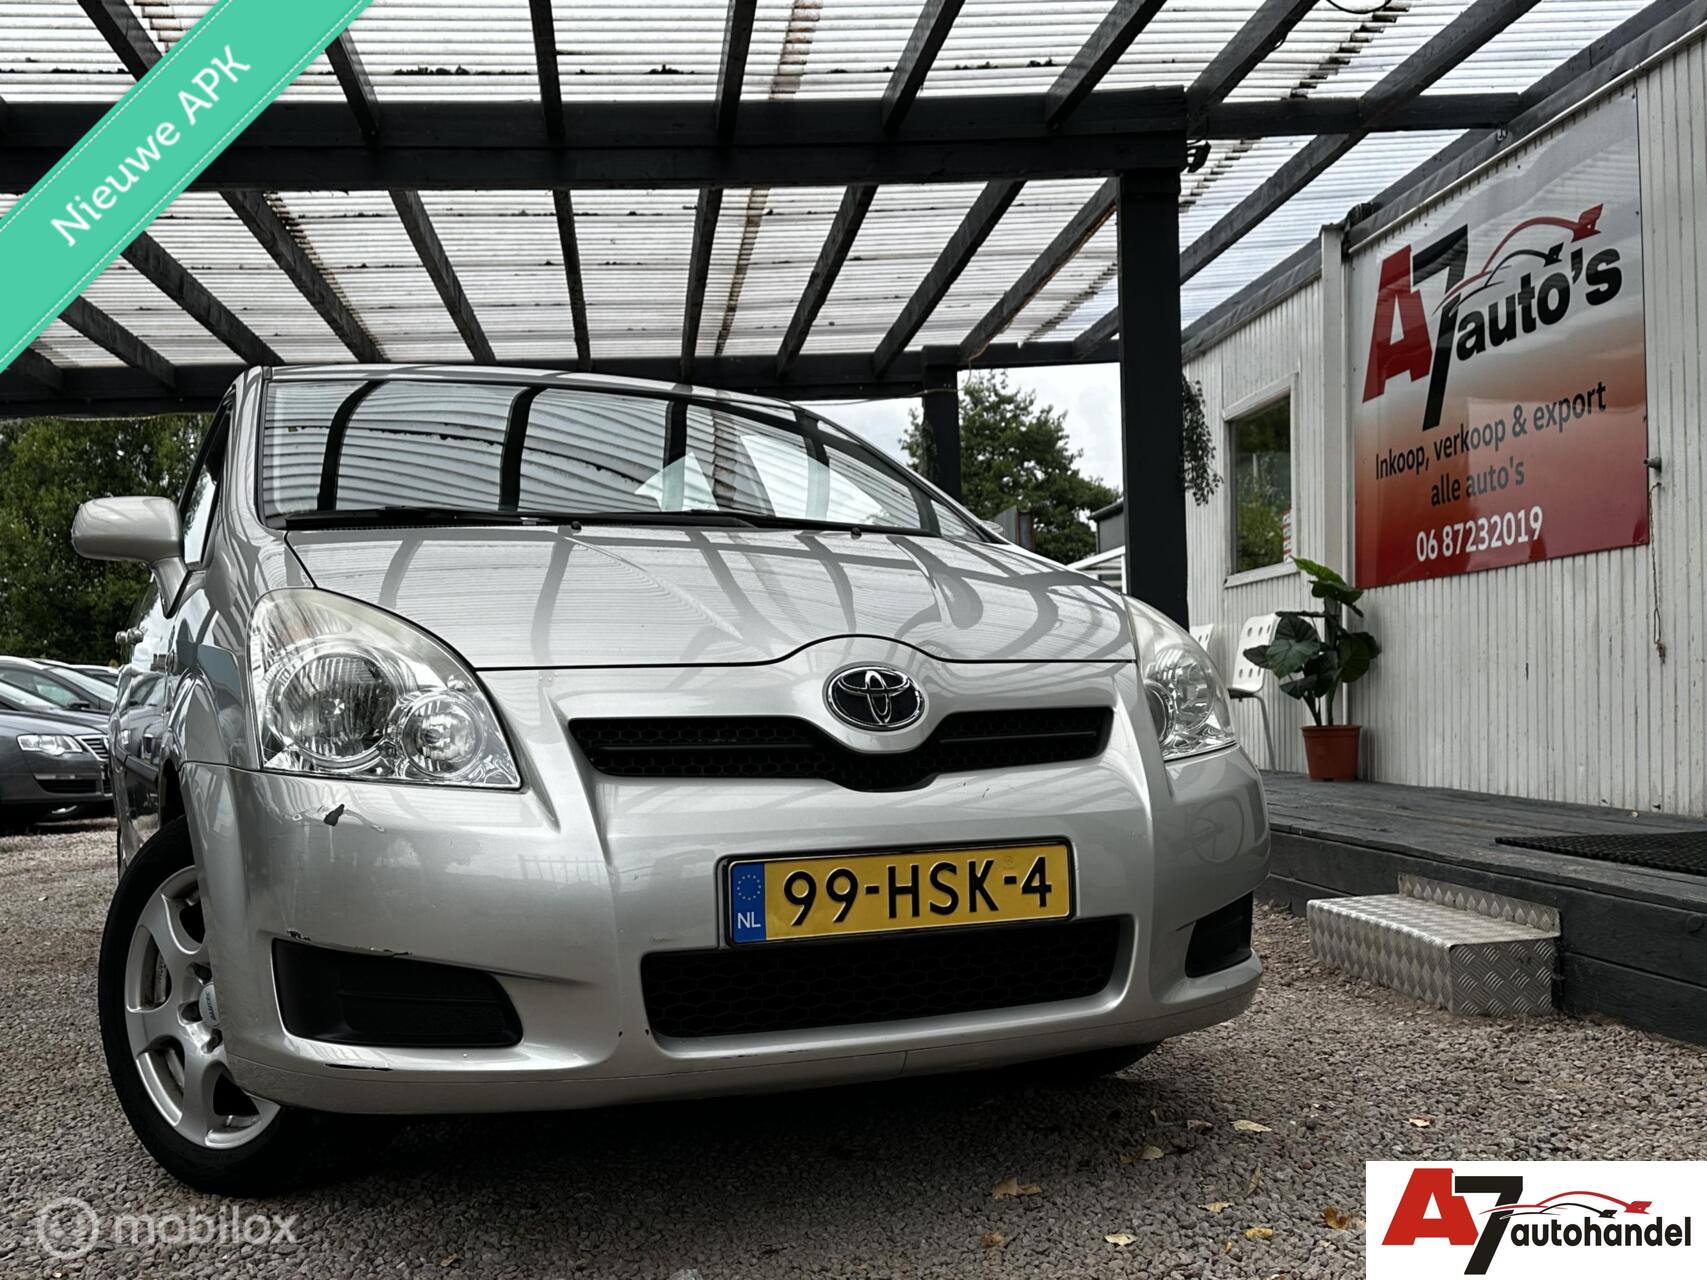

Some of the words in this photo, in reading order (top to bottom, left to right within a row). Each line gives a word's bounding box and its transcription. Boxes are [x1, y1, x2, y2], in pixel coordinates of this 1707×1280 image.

[1363, 224, 1468, 431] A7
[1456, 247, 1622, 361] auto's
[1375, 444, 1430, 480] Inkoop,
[1434, 423, 1506, 462] verkoop
[1512, 405, 1528, 438] &
[1533, 381, 1607, 434] export
[1431, 474, 1461, 507] alle
[1466, 456, 1525, 498] auto's
[1416, 528, 1438, 562] 06
[1442, 505, 1543, 558] 87232019
[737, 912, 761, 930] NL
[783, 856, 1052, 927] 99-HSK-4
